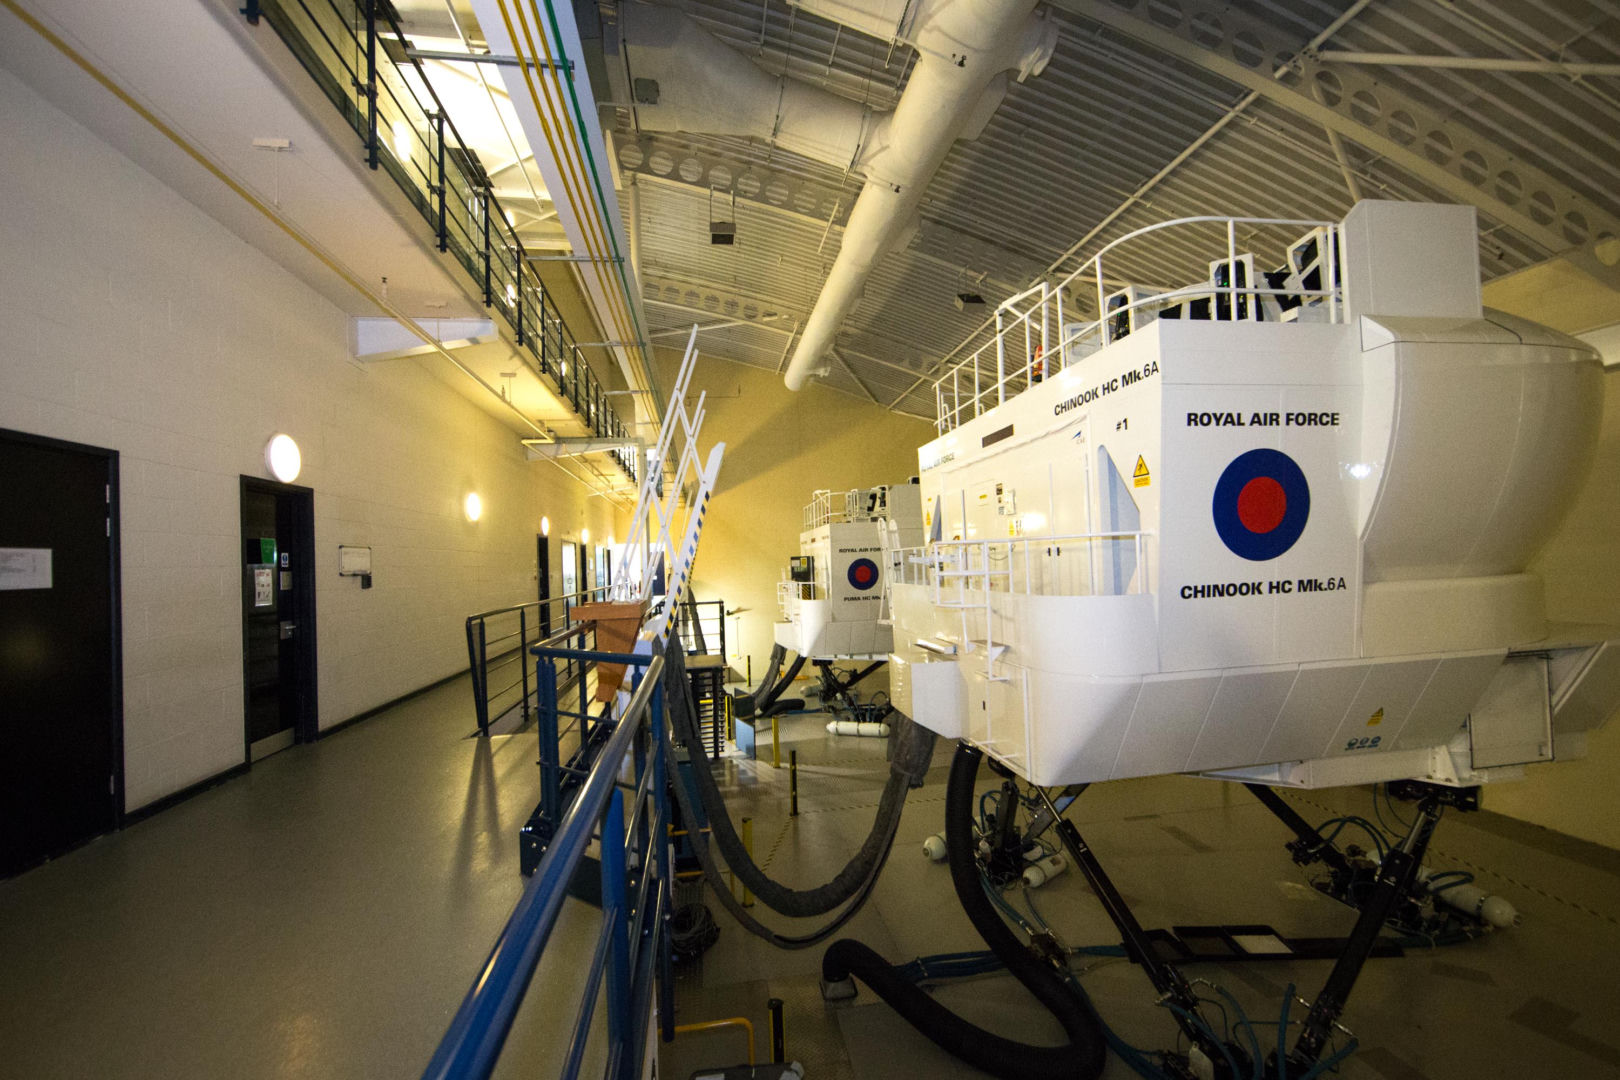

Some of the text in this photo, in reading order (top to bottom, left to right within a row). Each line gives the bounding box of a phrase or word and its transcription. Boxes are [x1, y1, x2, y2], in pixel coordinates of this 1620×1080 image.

[1054, 360, 1160, 416] CHINOOK HC Mk.6A
[1116, 418, 1129, 431] #1
[1187, 412, 1340, 427] ROYAL AIR FORCE
[1180, 576, 1347, 599] CHINOOK HC Mk.6A
